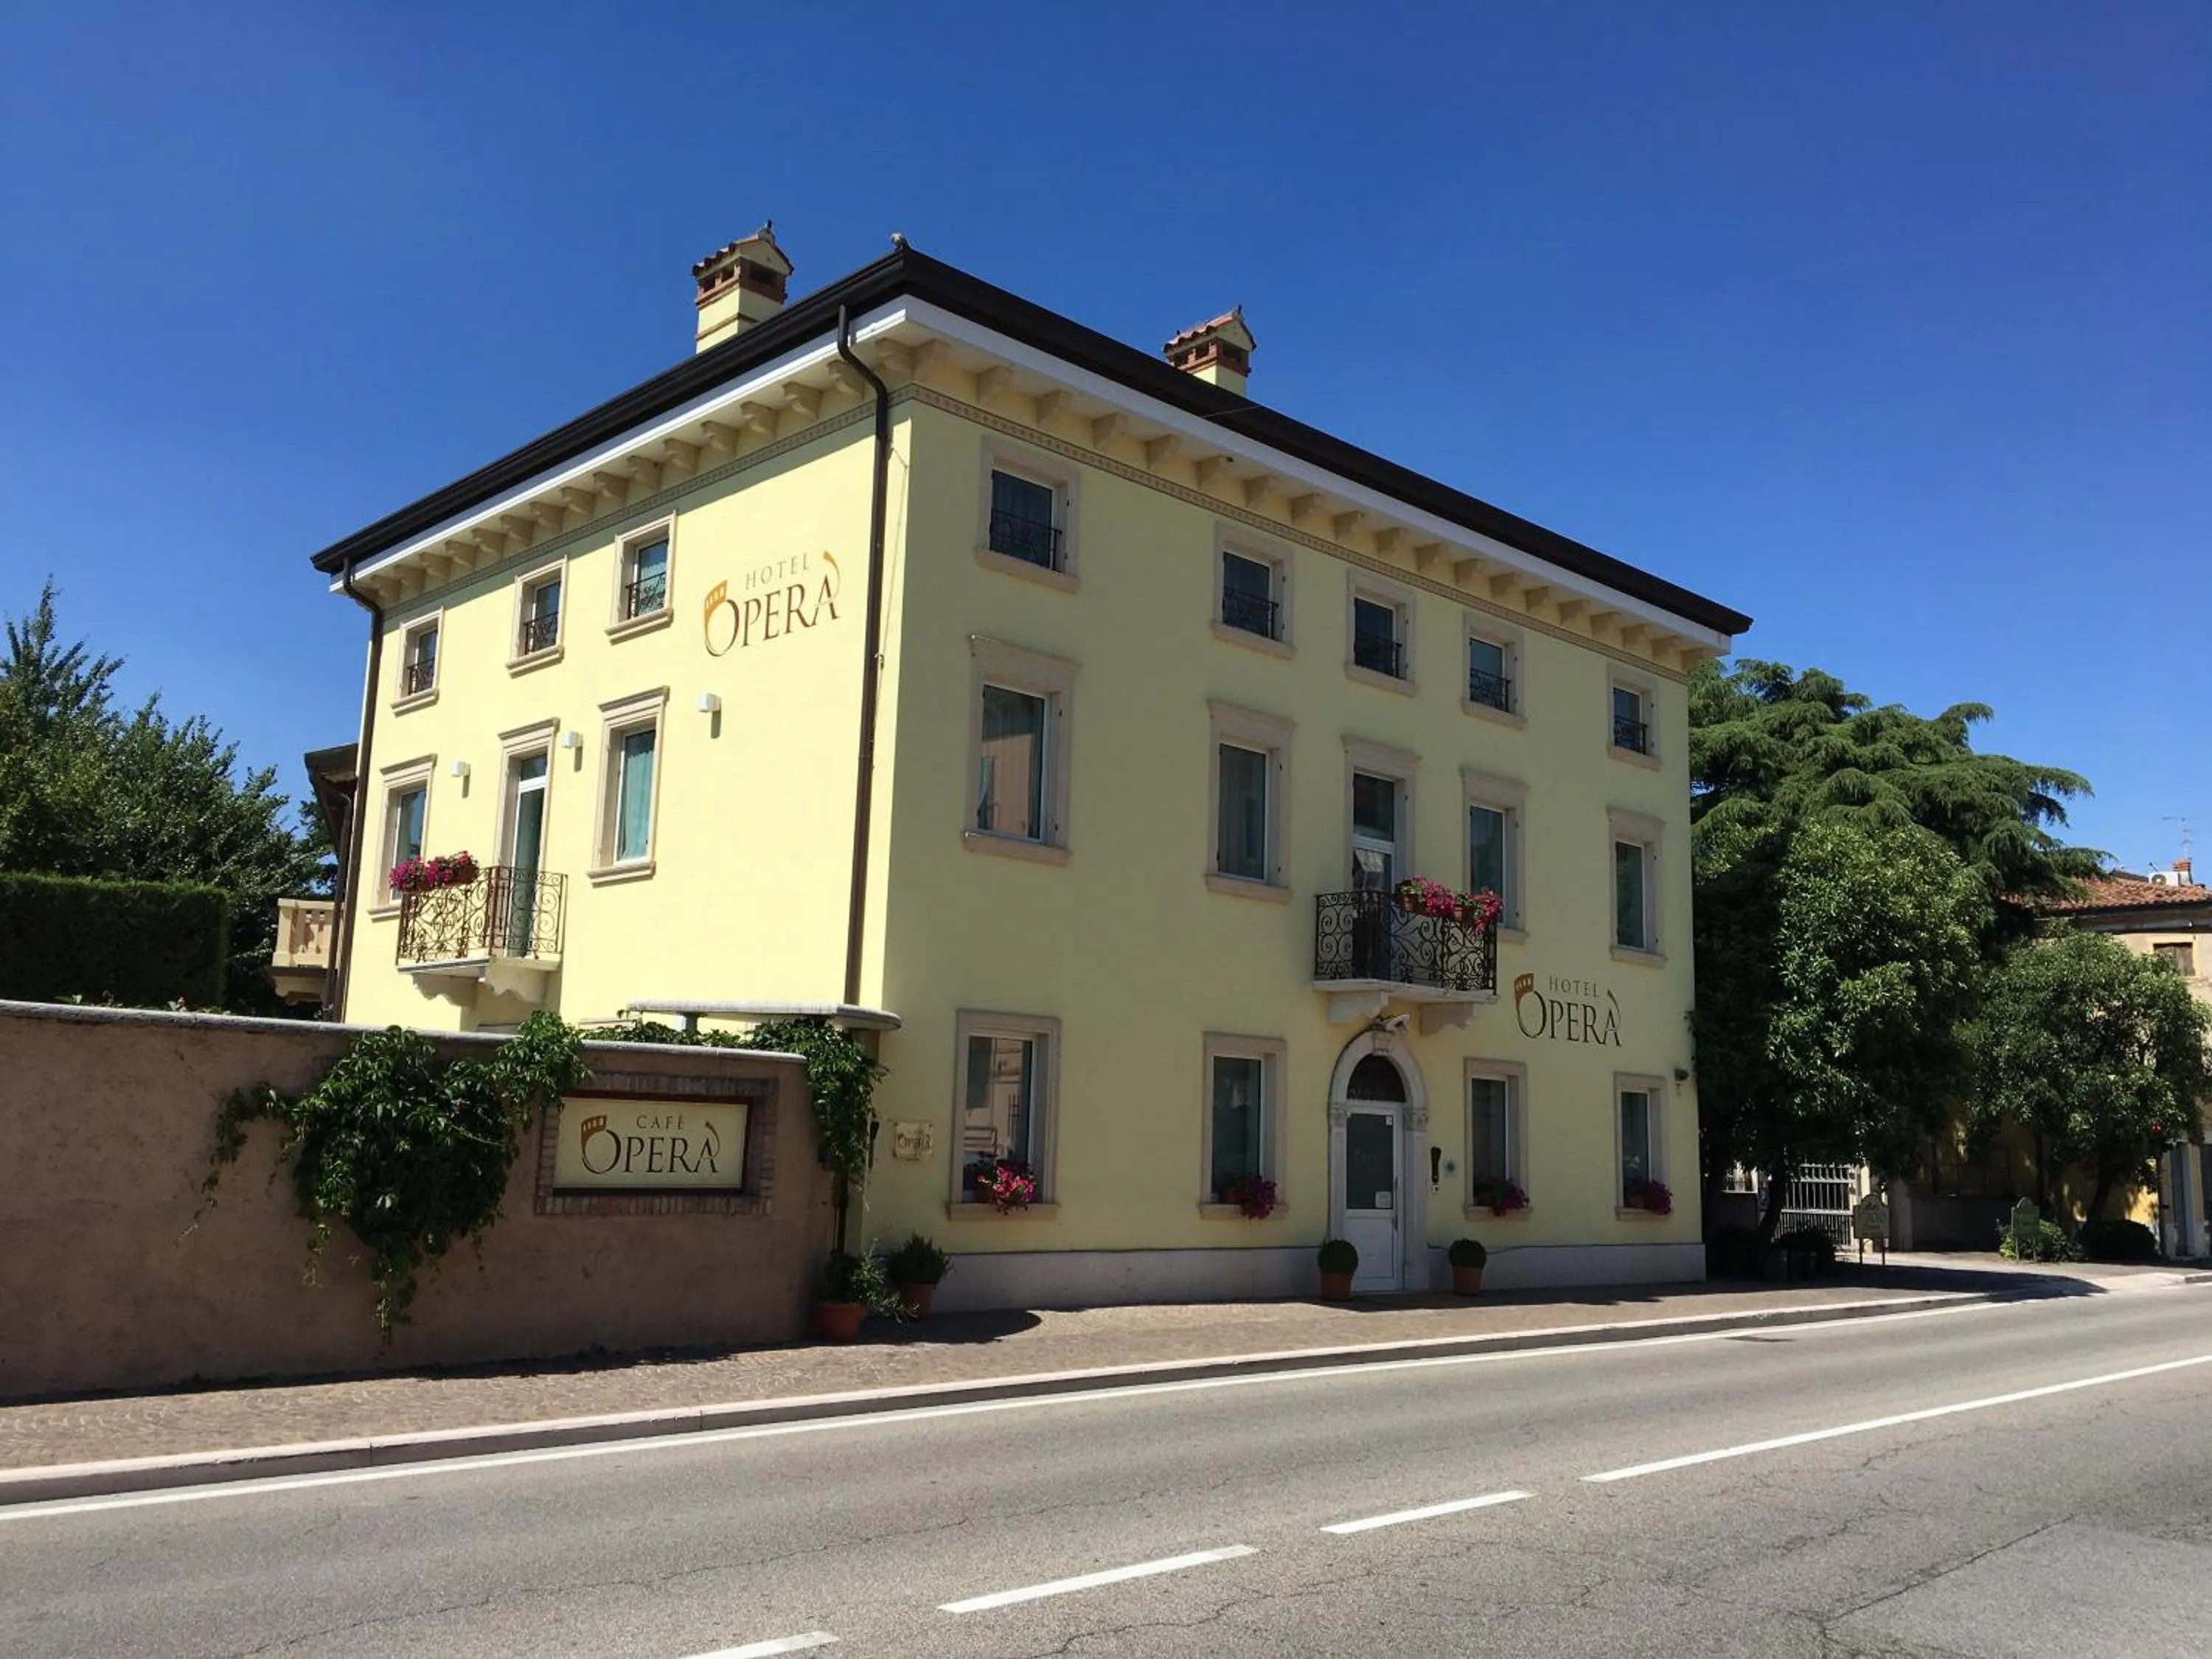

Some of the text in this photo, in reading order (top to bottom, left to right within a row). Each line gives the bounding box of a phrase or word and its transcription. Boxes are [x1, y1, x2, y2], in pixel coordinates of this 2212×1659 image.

[745, 552, 811, 590] HOTEL
[704, 571, 842, 658] OPERA
[1514, 975, 1621, 1047] OPERA
[1548, 975, 1600, 997] HOTEL
[580, 1116, 720, 1175] OPERA
